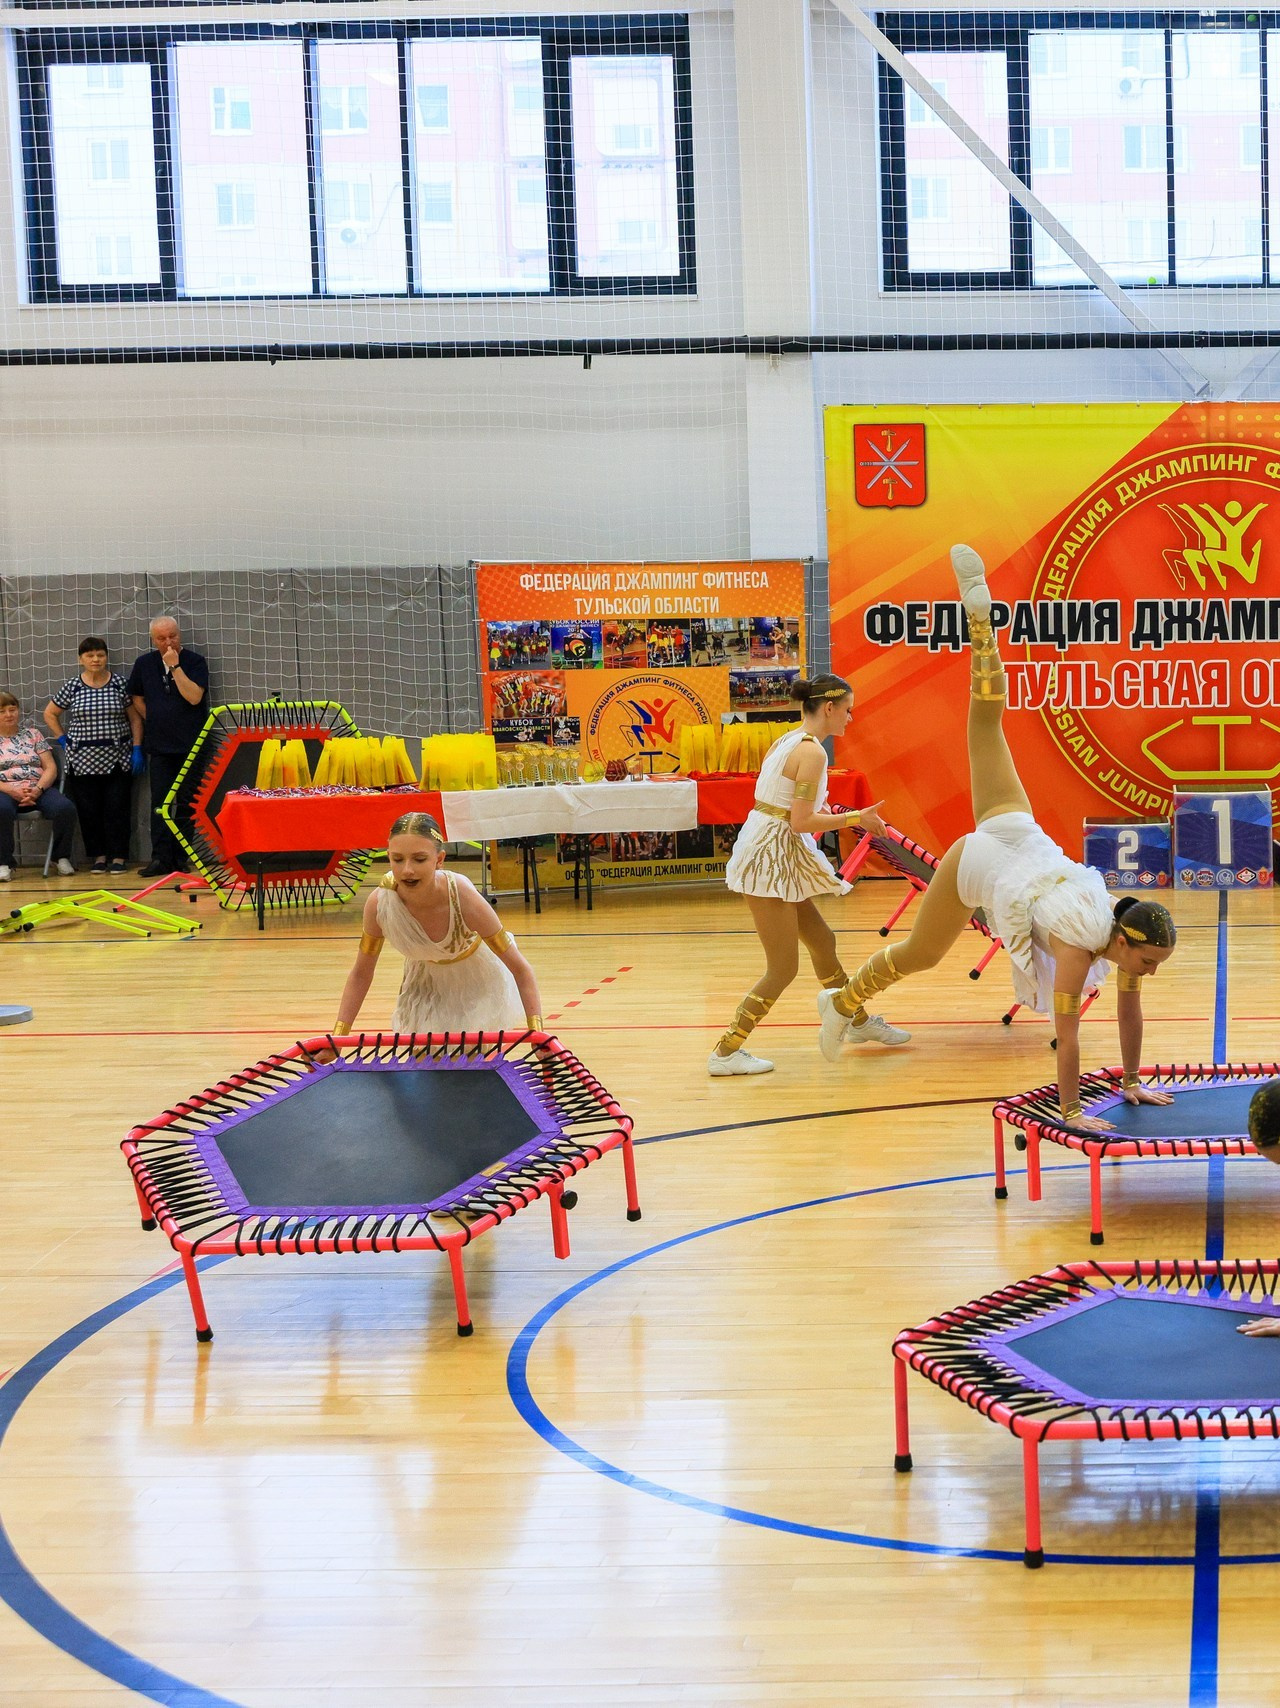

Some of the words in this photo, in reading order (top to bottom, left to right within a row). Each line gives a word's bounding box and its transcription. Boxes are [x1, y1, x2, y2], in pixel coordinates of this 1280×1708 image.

[1042, 497, 1114, 600] ДЕРАЦИЯ
[1115, 453, 1258, 506] ДЖАМПИНГ
[519, 572, 611, 592] ФЕДЕРАЦИЯ
[613, 571, 699, 591] ДЖАМПИНГ
[702, 571, 769, 589] ФИТНЕСА
[573, 595, 651, 615] ТУЛЬСКОЙ
[654, 596, 720, 614] ОБЛАСТИ
[865, 600, 1121, 651] ФЕДРАЦИЯ
[589, 690, 616, 736] ФЕДЕРАЦИЯ
[615, 677, 662, 693] ДЖАМПИНГ
[662, 679, 696, 703] ФИТНЕСА
[1005, 660, 1230, 710] ТУЛЬСКАЯ
[1098, 768, 1174, 817] JUMPI
[1117, 830, 1140, 870] 2
[1211, 799, 1232, 865] 1
[596, 865, 652, 879] "ФЕДЕРАЦИЯ
[653, 863, 703, 877] ДЖАМПИНГ
[704, 862, 727, 873] ФИТН
